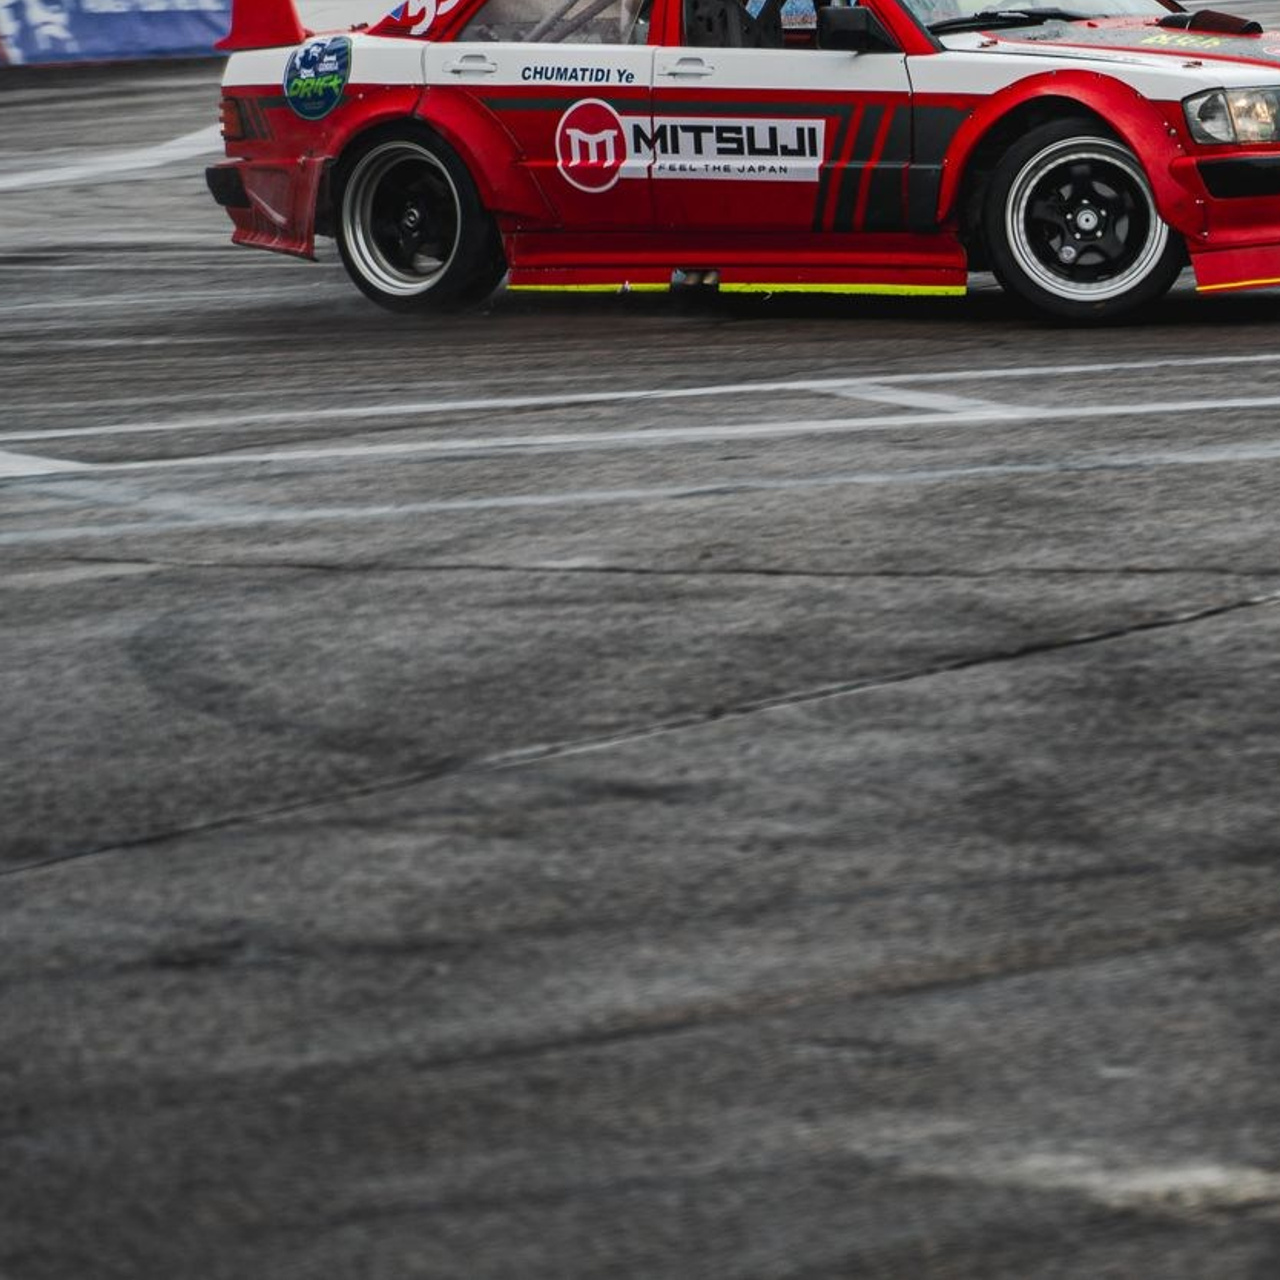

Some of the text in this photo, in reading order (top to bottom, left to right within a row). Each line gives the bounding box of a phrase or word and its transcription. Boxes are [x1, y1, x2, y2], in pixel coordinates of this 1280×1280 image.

[521, 66, 635, 83] CHUMATIDI Ye
[632, 123, 818, 158] MITSUJI
[658, 164, 788, 174] FEEL THE JAPAN
